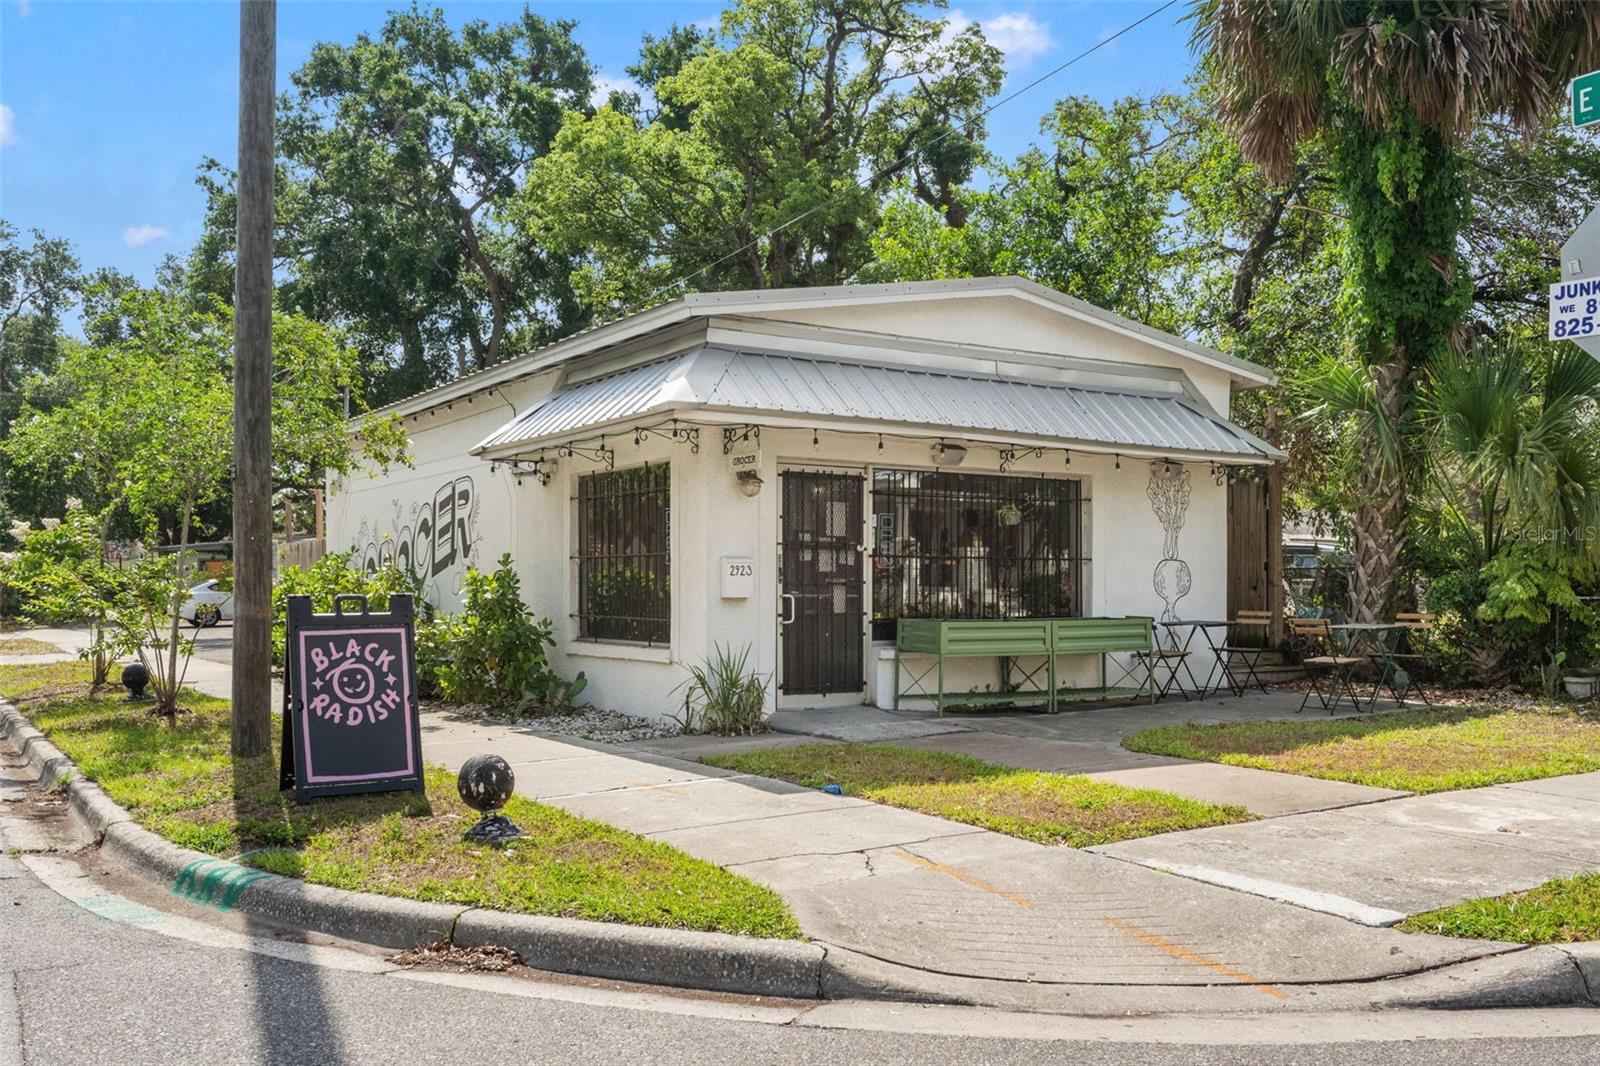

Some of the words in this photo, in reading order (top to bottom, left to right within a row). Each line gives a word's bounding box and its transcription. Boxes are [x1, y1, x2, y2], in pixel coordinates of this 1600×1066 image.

[1580, 87, 1593, 113] E
[1554, 280, 1600, 300] JUNK
[1560, 304, 1575, 314] WE
[1586, 298, 1600, 314] 8
[732, 454, 756, 466] GROCER
[730, 564, 753, 576] 2923
[310, 638, 396, 673] BLACK
[309, 688, 401, 726] RADISH
